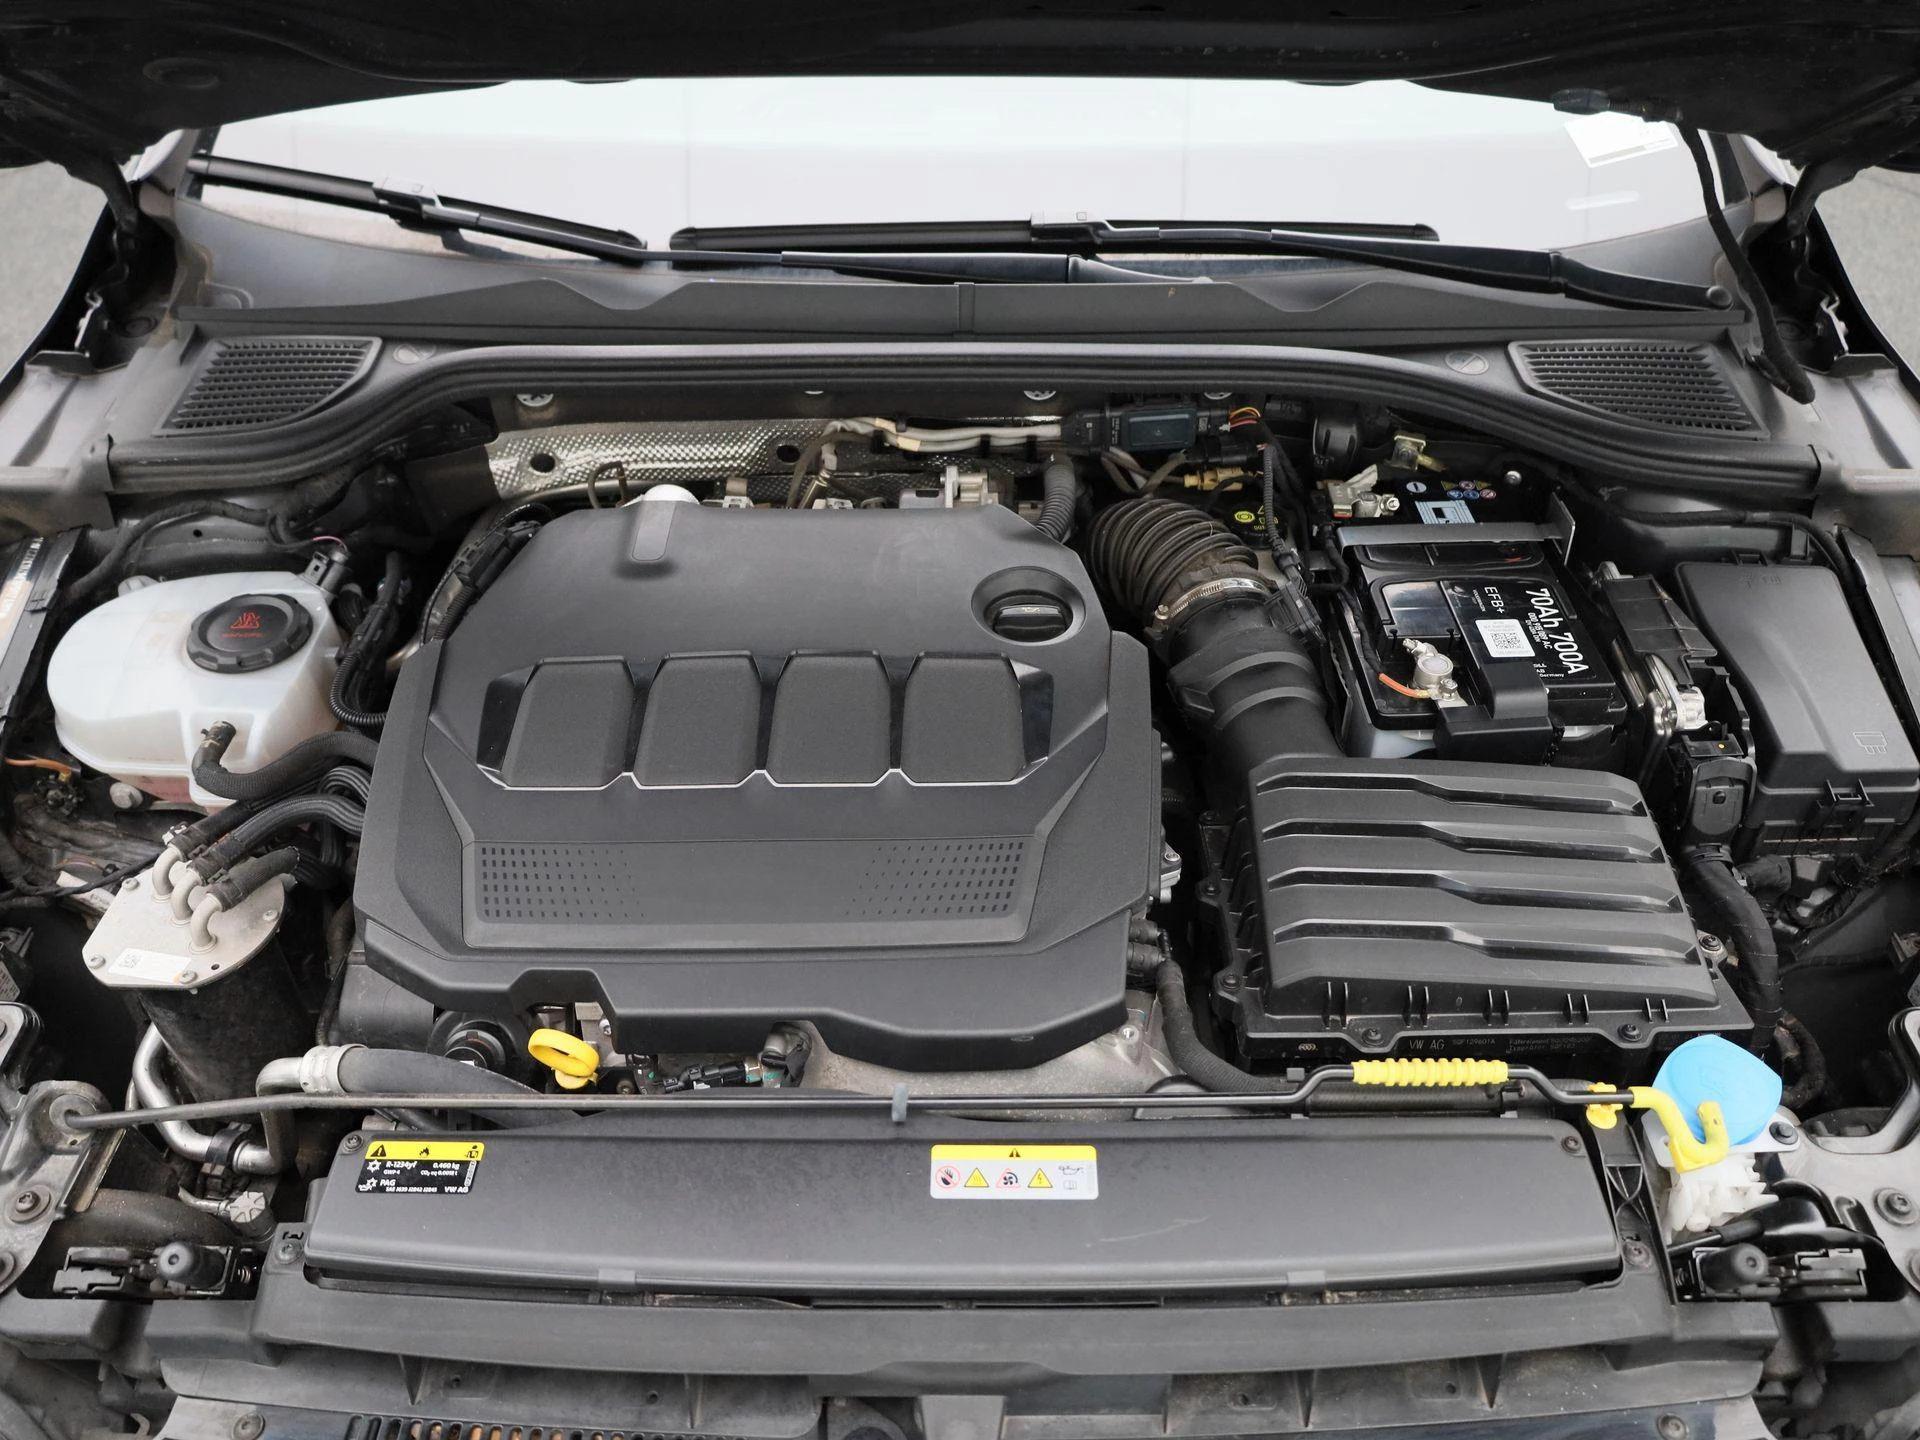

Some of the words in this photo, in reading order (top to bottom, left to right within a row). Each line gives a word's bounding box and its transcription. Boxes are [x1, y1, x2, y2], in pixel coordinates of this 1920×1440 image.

[1484, 586, 1505, 614] EFB+
[1526, 588, 1564, 628] 70Ah
[1549, 632, 1589, 674] 700A
[1542, 640, 1553, 650] AC
[1409, 1039, 1424, 1050] VW
[1429, 1039, 1445, 1050] AG
[386, 1161, 417, 1170] R-1234yf
[452, 1162, 460, 1170] kg
